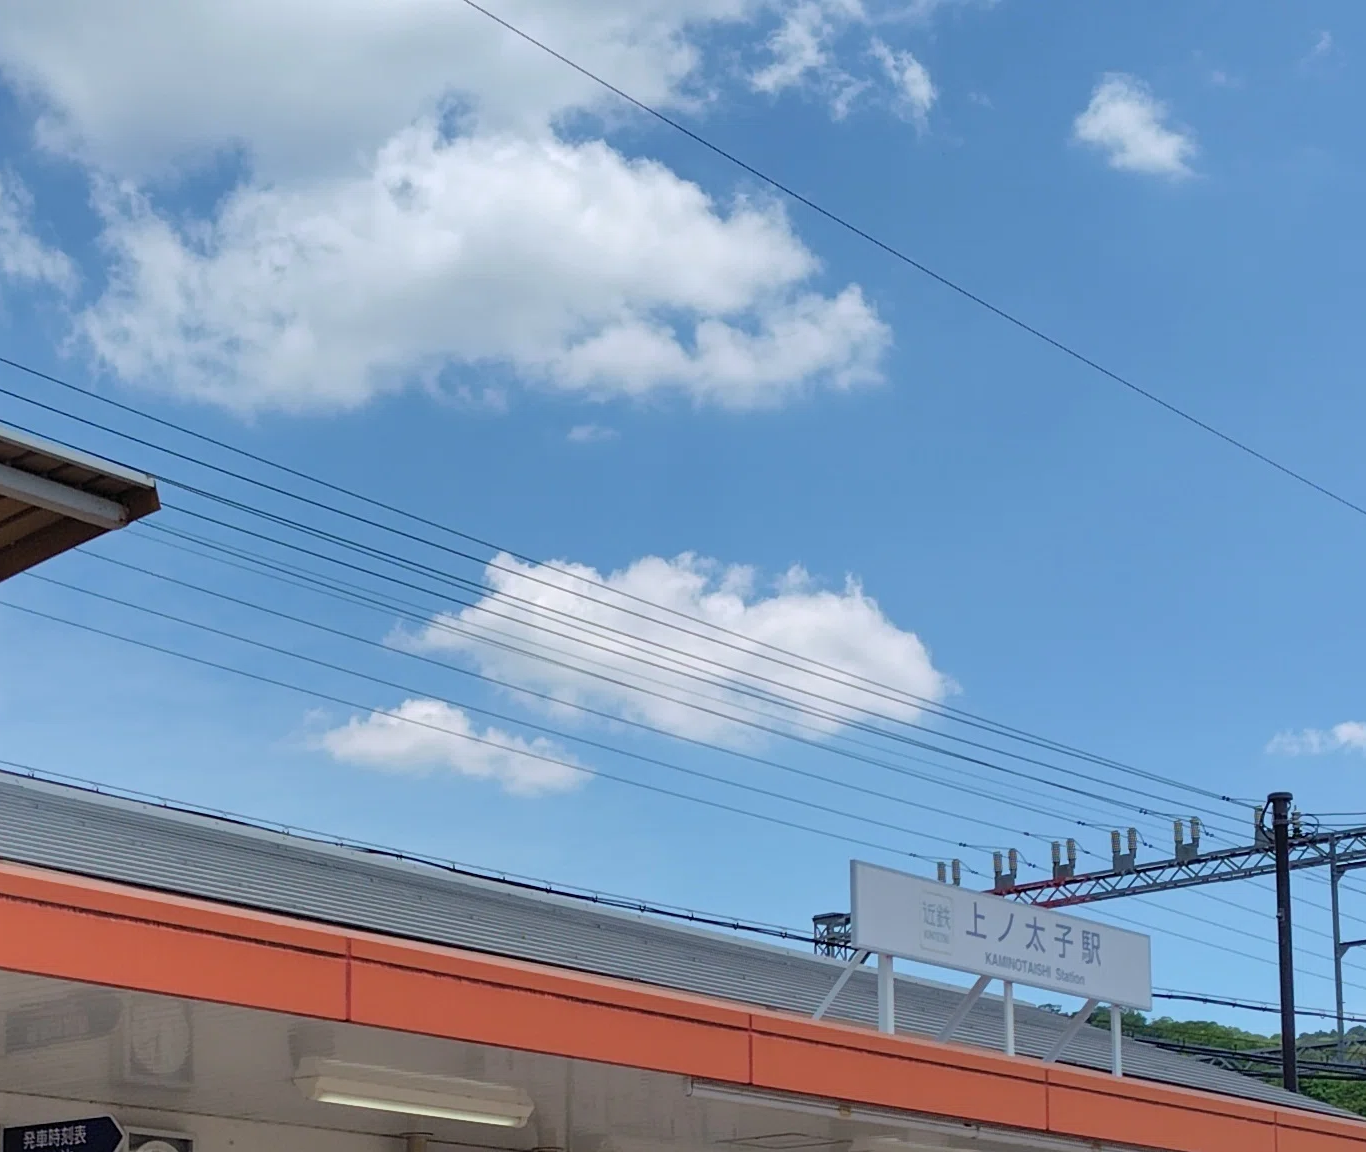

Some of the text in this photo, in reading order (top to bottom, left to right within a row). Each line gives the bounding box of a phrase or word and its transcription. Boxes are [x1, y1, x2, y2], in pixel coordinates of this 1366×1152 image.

[922, 901, 951, 930] 近鉄
[966, 902, 1101, 967] 上ノ太子駅
[985, 952, 1085, 986] KAMINOTAISHI Station
[23, 1125, 87, 1150] 発車時刻表
